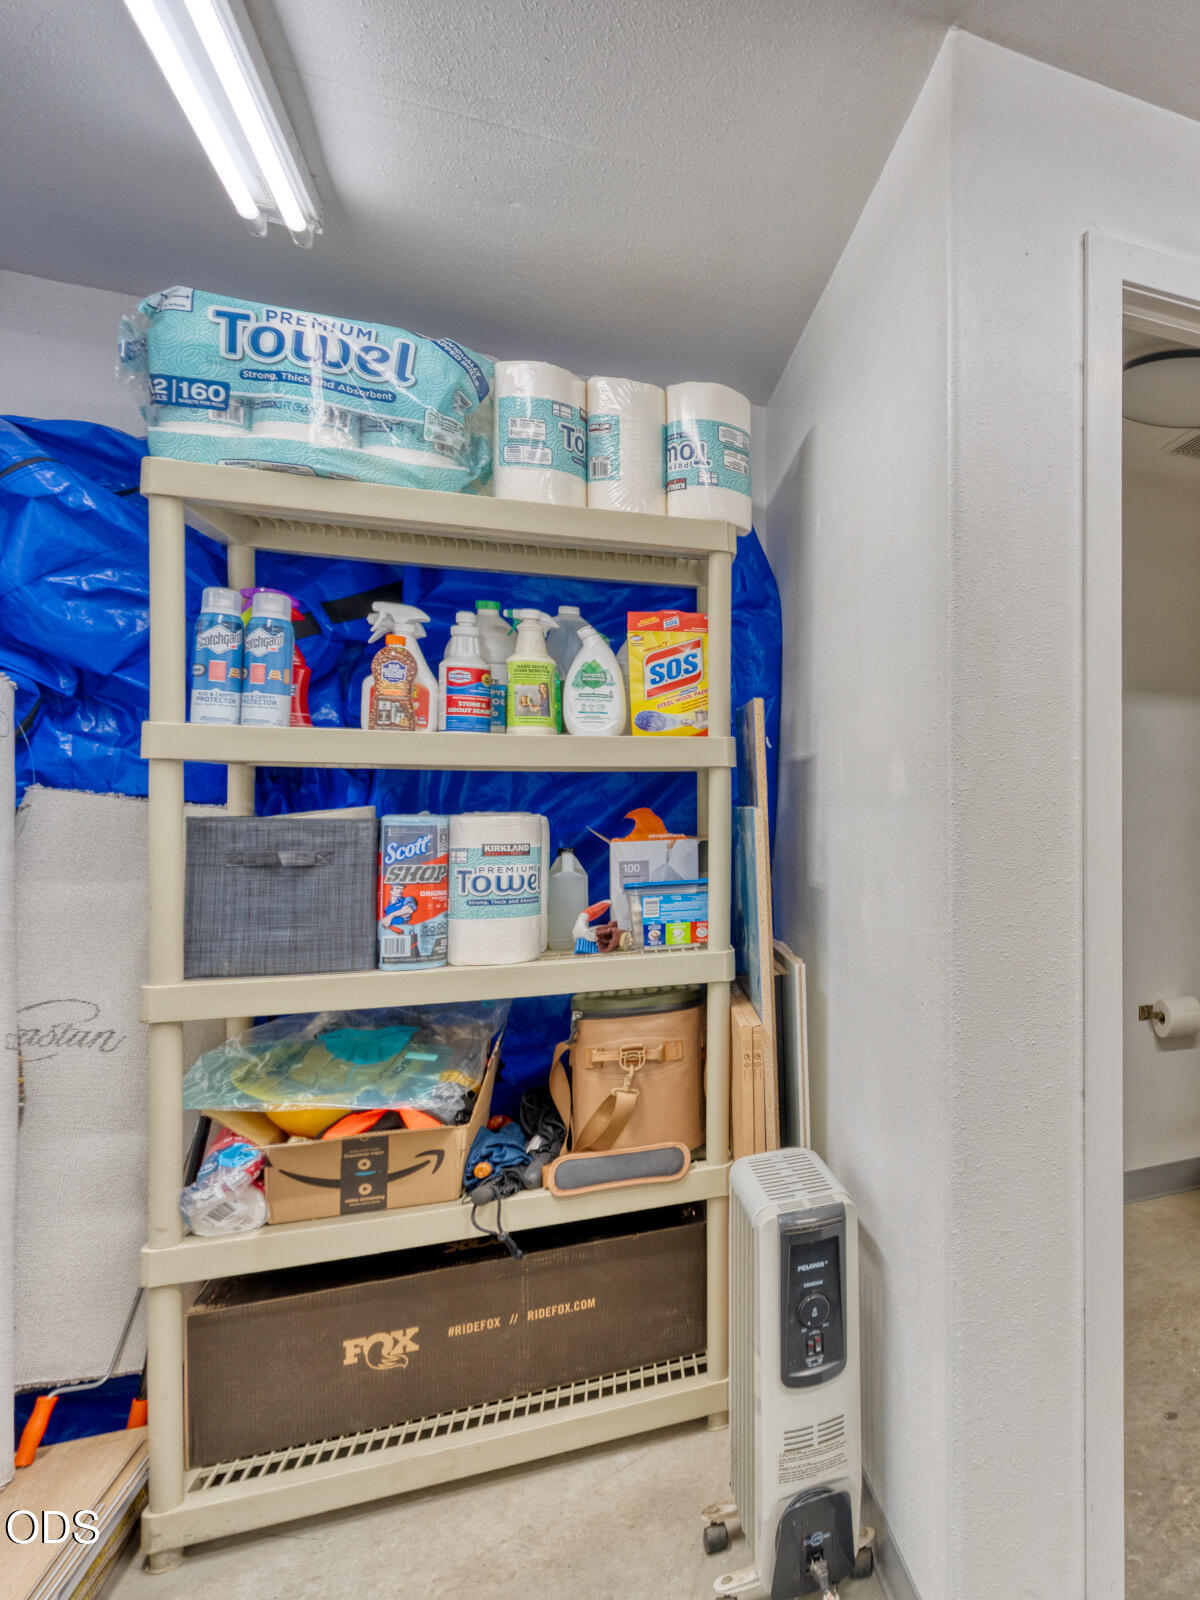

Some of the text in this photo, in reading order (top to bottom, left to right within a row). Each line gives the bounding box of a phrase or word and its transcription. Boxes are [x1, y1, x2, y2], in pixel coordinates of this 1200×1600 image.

[265, 309, 373, 341] PREMIUM
[210, 308, 415, 386] Towel
[242, 370, 279, 381] Strong,
[282, 372, 311, 384] Thick
[179, 381, 226, 402] 160
[384, 834, 433, 865] Scott
[483, 844, 530, 853] KIRKLAND
[384, 865, 448, 885] SHOP
[478, 865, 537, 874] PREMIUM
[622, 863, 640, 873] 100
[448, 1316, 501, 1338] #RIDEFOX
[527, 1297, 596, 1322] RIDEFOX.COM
[343, 1326, 420, 1371] FOX
